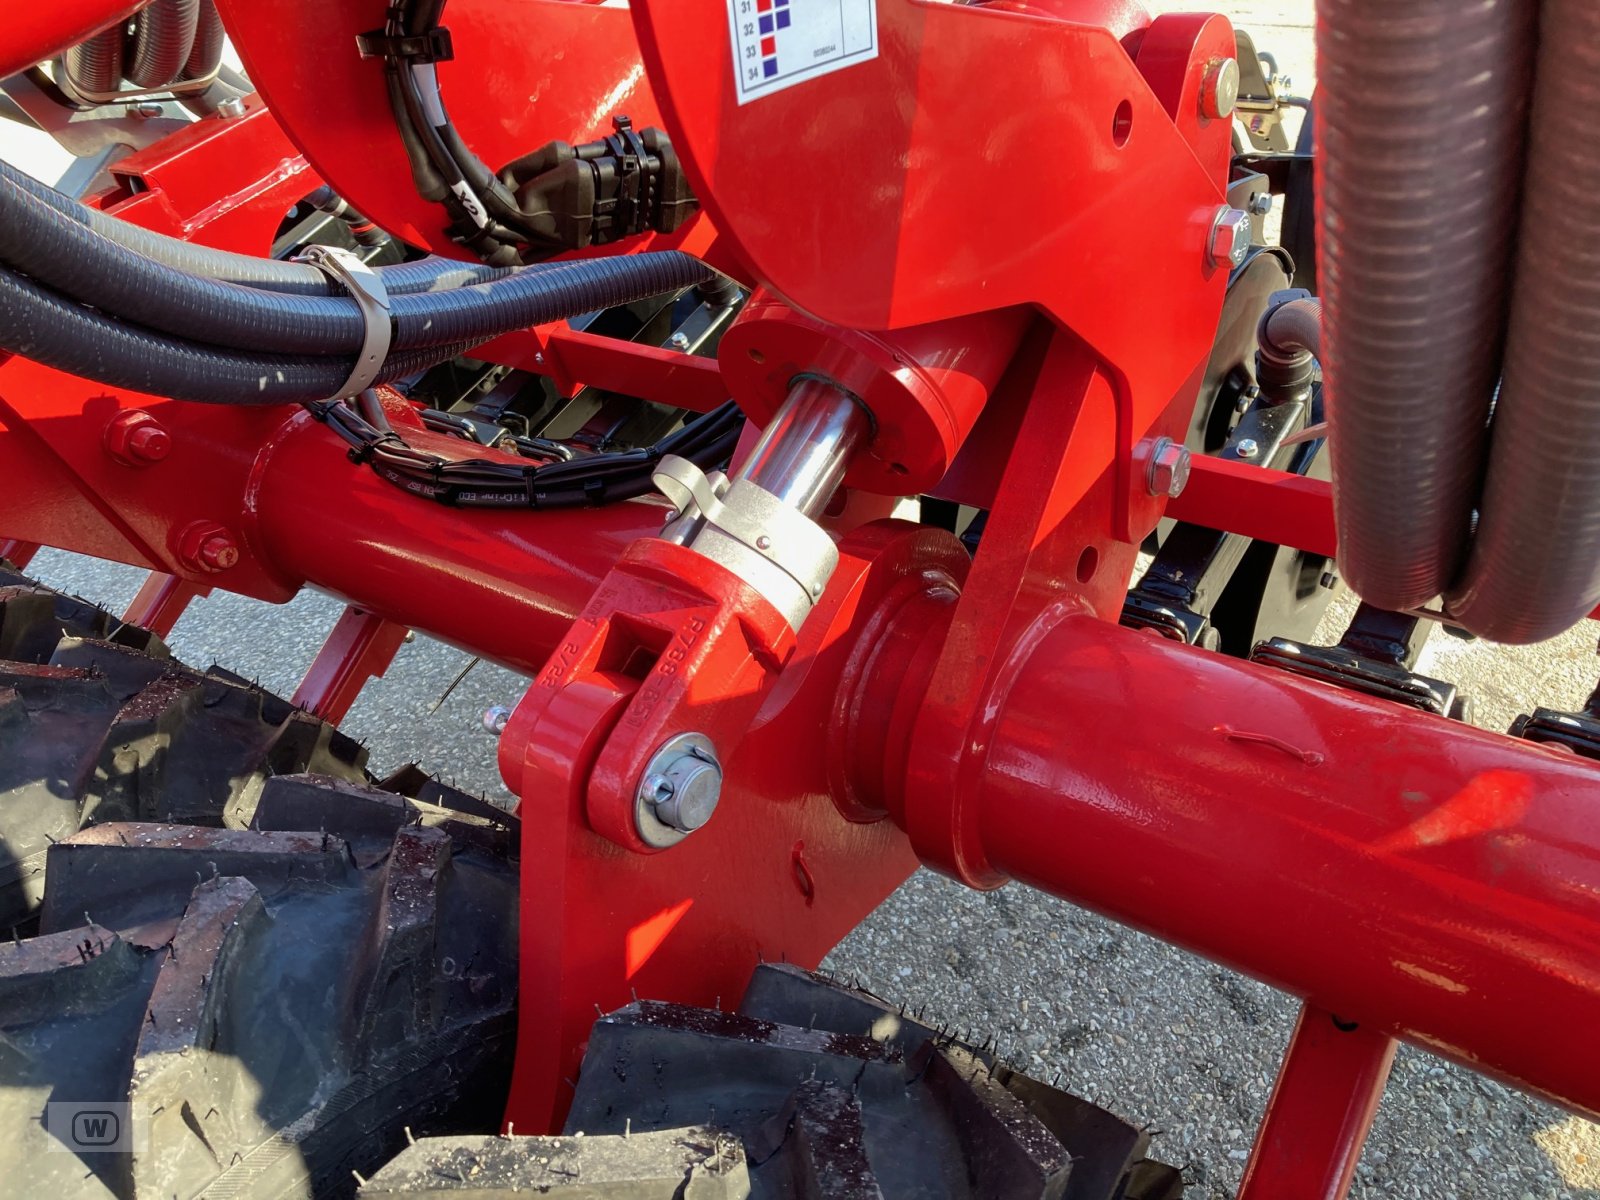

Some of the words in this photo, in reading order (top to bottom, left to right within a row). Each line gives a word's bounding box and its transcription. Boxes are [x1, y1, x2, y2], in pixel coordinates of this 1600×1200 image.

[741, 0, 751, 13] 31
[744, 22, 754, 36] 32
[746, 45, 756, 58] 33
[748, 67, 759, 81] 34
[457, 491, 476, 501] ECO
[481, 491, 546, 502] mutiCrimp
